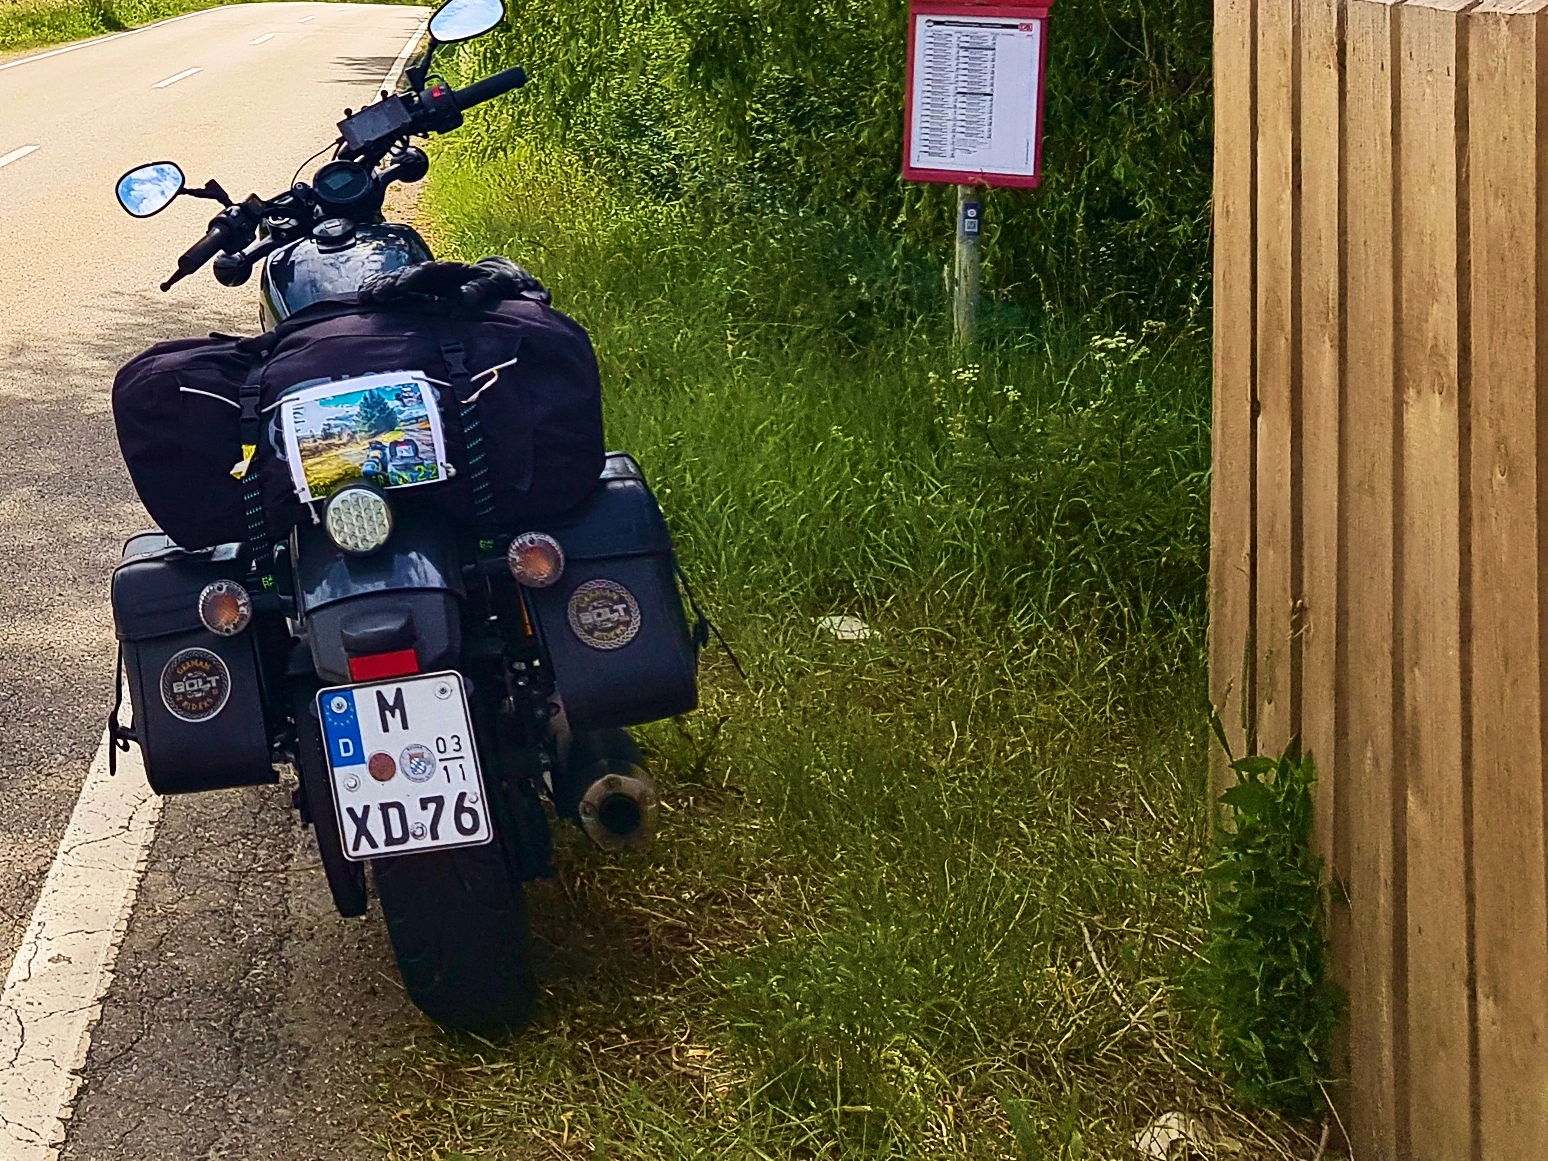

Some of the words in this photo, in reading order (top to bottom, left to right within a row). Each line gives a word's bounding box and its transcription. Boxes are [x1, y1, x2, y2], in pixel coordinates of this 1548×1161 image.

[578, 603, 627, 624] BOLT
[172, 675, 220, 693] BOLT
[375, 687, 409, 734] M
[338, 738, 354, 758] D
[435, 734, 462, 754] 03
[442, 763, 466, 784] 11
